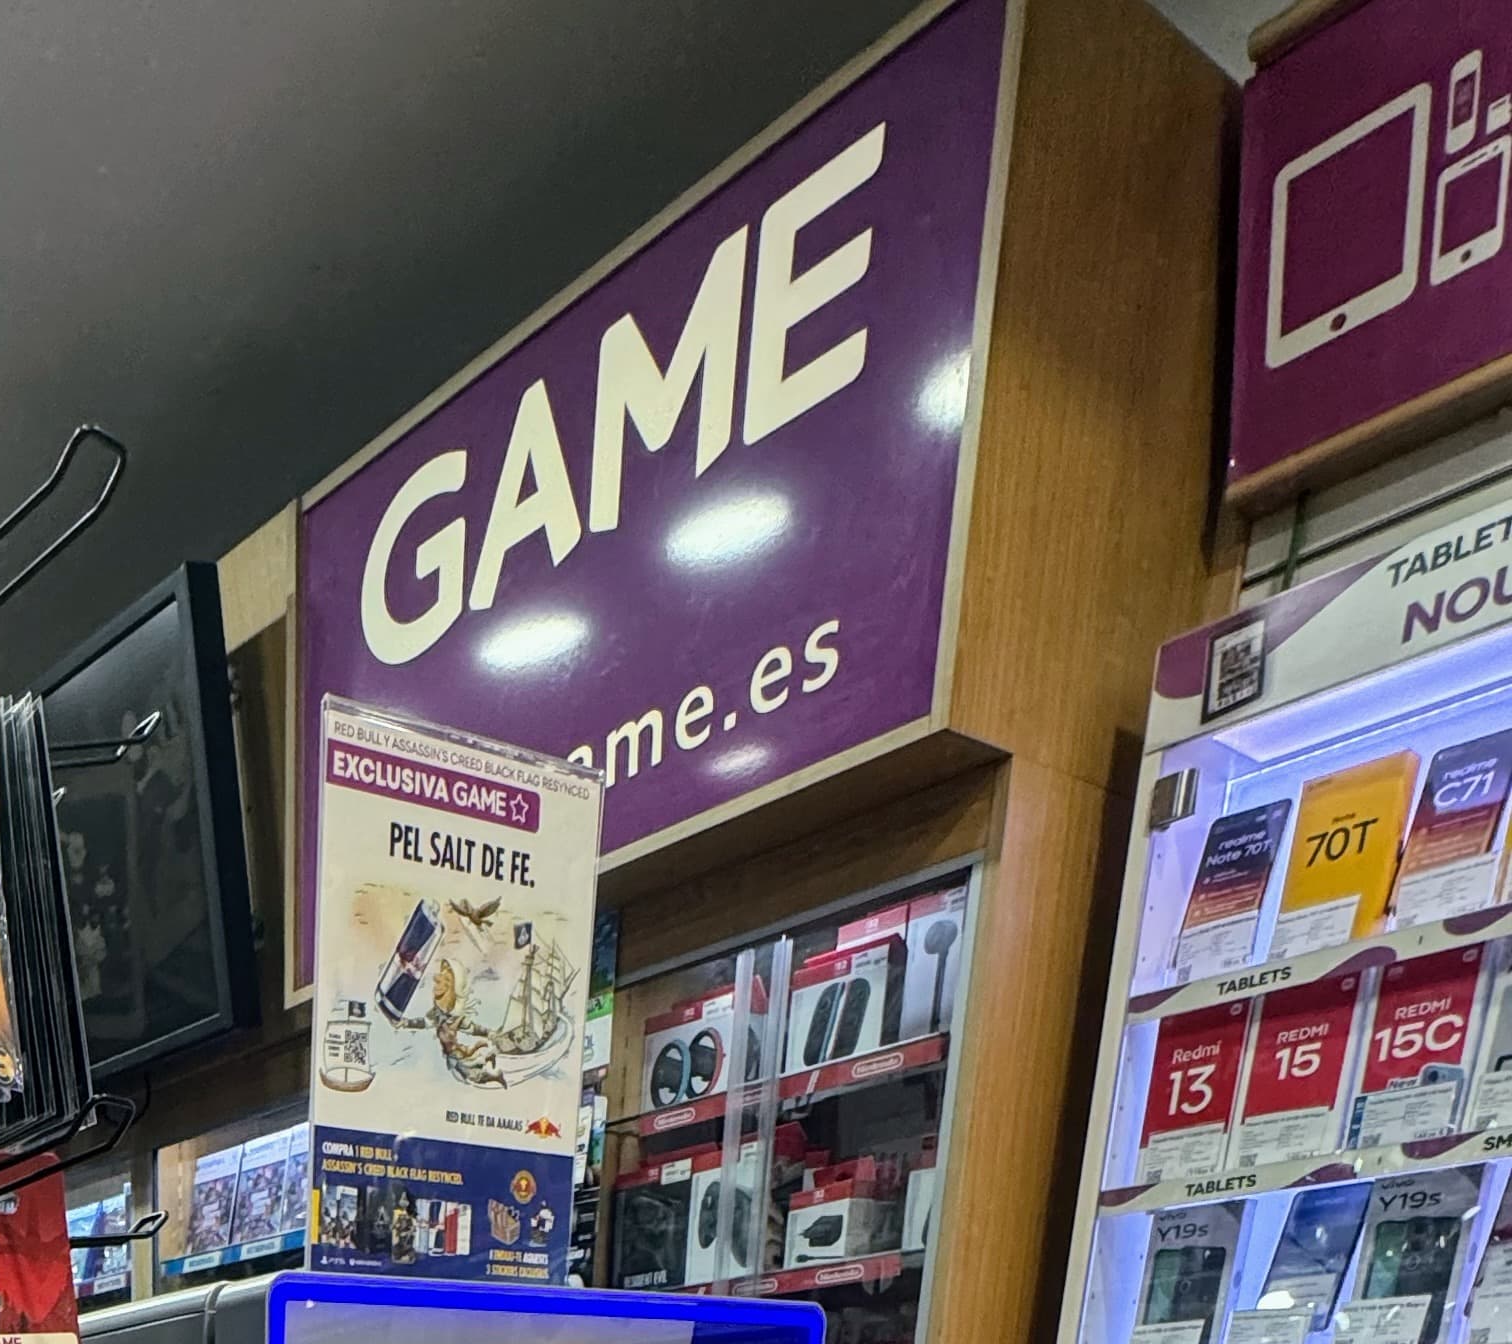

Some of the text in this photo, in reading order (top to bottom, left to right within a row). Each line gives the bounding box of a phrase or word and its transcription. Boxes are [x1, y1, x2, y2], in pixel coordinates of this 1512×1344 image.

[361, 121, 885, 665] GAME
[334, 721, 354, 738] RED
[356, 725, 382, 745] BULL
[392, 735, 448, 762] ASSASSIN'S
[450, 751, 483, 772] CREED
[485, 760, 514, 780] BLACK
[516, 767, 539, 787] FLAG
[540, 774, 589, 799] RESYNCED
[333, 752, 506, 817] EXCLUSIVA GAME
[1434, 772, 1495, 807] C71
[390, 822, 535, 888] PEL SALT DE FE.
[1244, 839, 1271, 857] 70T
[1306, 818, 1379, 868] 70T
[1217, 967, 1291, 995] TABLETS
[1395, 997, 1452, 1020] REDMI
[1277, 1023, 1329, 1044] REDMI
[1374, 1014, 1463, 1062] 15C
[1172, 1044, 1220, 1065] Redmi
[1275, 1044, 1321, 1080] 15
[1168, 1066, 1213, 1116] 13
[446, 1111, 458, 1122] RED
[460, 1112, 475, 1124] BULL
[478, 1114, 485, 1125] TE
[323, 1143, 353, 1157] COMPRA
[1185, 1175, 1256, 1196] TABLETS
[1380, 1192, 1441, 1211] Y19s
[1157, 1224, 1208, 1241] Y19s
